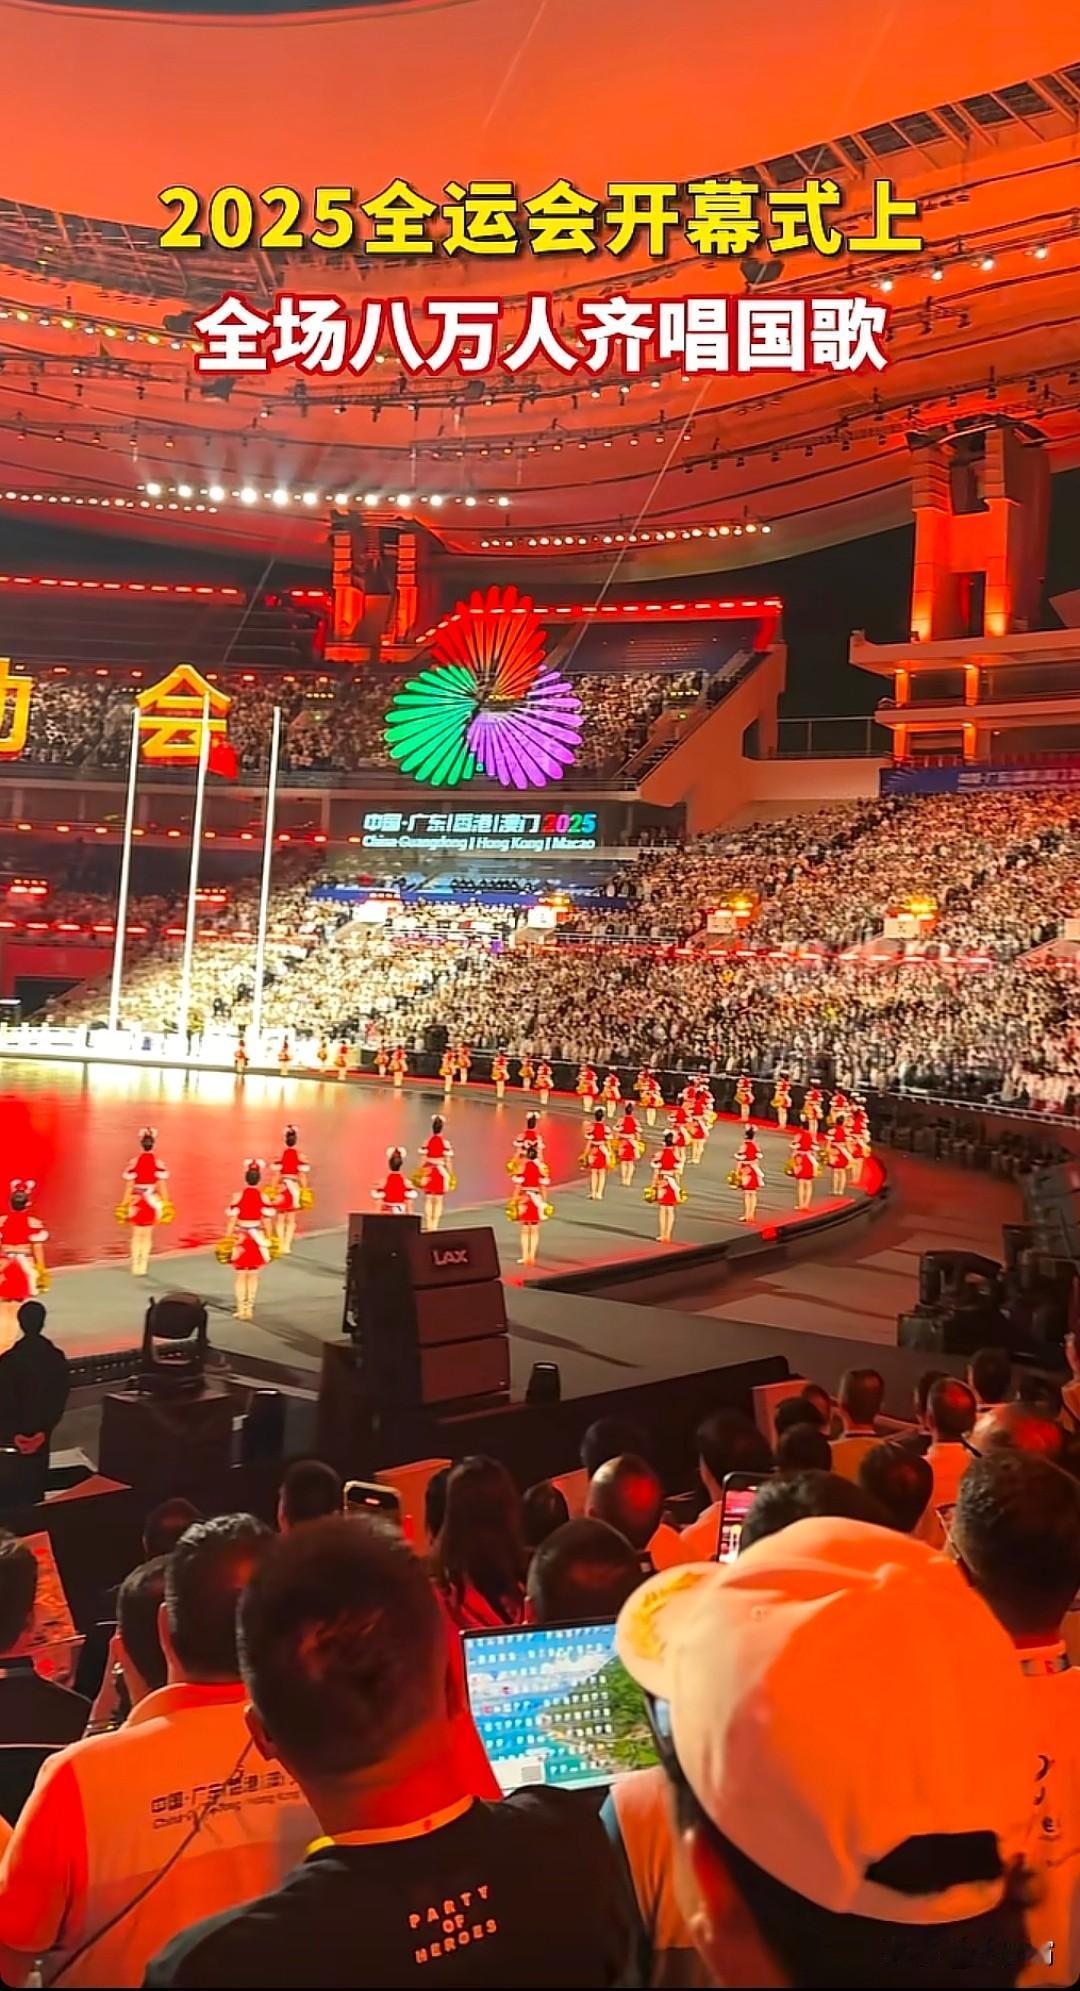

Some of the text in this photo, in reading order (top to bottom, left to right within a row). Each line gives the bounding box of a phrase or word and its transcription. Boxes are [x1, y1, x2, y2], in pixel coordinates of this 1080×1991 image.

[542, 812, 598, 834] 2025
[408, 1884, 489, 1929] PARTY
[442, 1913, 465, 1934] OF
[415, 1918, 498, 1964] HEROES
